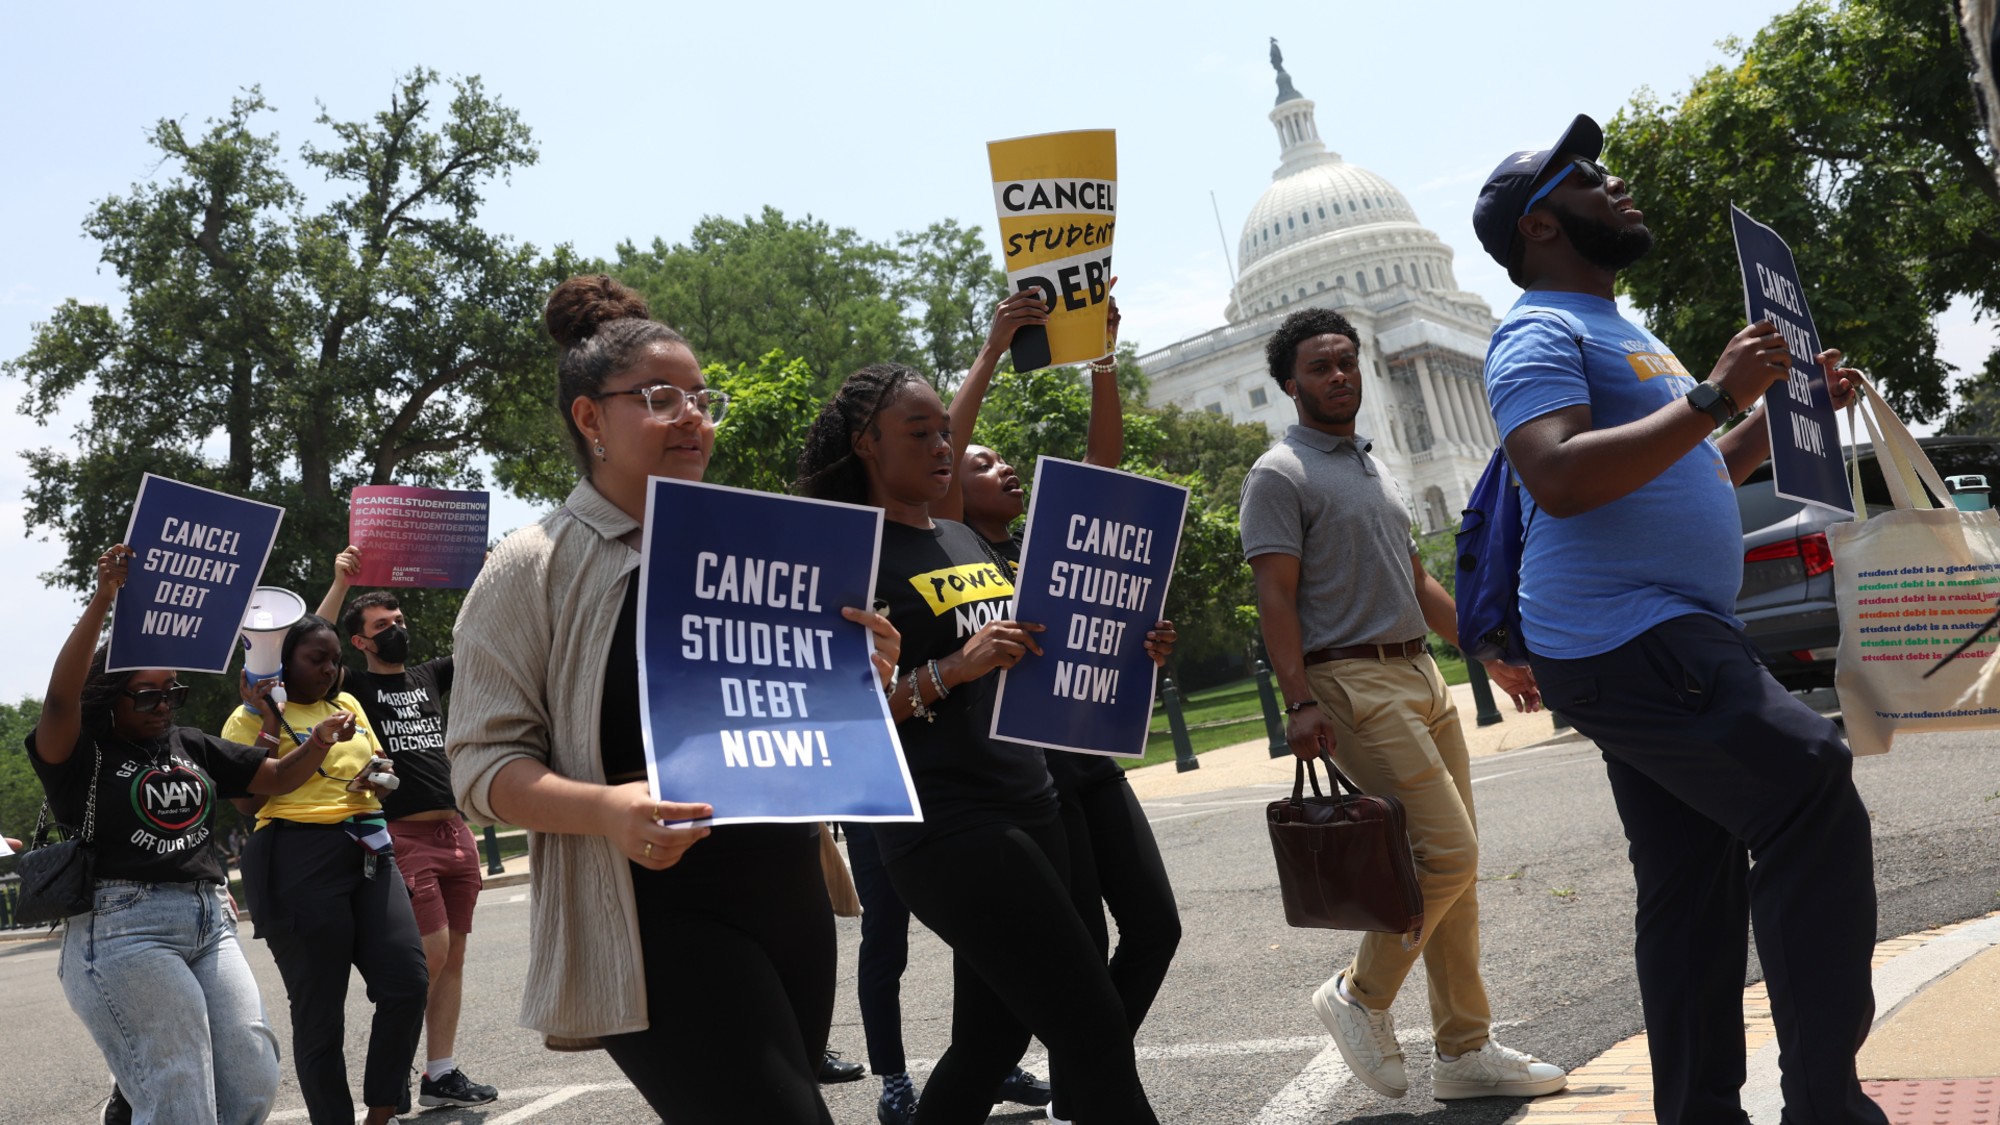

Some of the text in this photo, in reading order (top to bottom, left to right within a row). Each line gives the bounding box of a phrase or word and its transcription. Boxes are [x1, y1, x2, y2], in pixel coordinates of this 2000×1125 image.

[1002, 181, 1114, 212] CANCEL
[1007, 222, 1114, 257] STUDENT
[1756, 262, 1803, 317] CANCEL
[1790, 411, 1826, 458] NOW!
[355, 496, 487, 511] #CANCELSTUDENTDEBTNOW
[355, 507, 487, 521] #CANCELSTUDENTDEBTNOW
[160, 517, 241, 555] CANCEL
[354, 518, 487, 532] #CANCELSTUDENTDEBTNOW
[1066, 513, 1153, 565] CANCEL
[143, 548, 240, 585] STUDENT
[1858, 567, 1898, 578] student
[1900, 566, 1923, 575] debt
[154, 580, 209, 609] DEBT
[694, 551, 822, 613] CANCEL
[930, 568, 1010, 603] POWE
[1048, 560, 1152, 612] STUDENT
[1858, 581, 1898, 591] student
[1901, 580, 1924, 589] debt
[1858, 596, 1899, 605] student
[1901, 595, 1924, 603] debt
[1927, 594, 1937, 602] is
[1948, 592, 1981, 601] racial
[141, 610, 202, 639] NOW!
[955, 600, 1013, 639] MOV
[1859, 610, 1899, 619] student
[1902, 609, 1926, 617] debt
[1929, 608, 1938, 616] is
[1860, 624, 1901, 633] student
[1904, 622, 1927, 631] debt
[681, 613, 833, 670] STUDENT
[1066, 613, 1126, 656] DEBT
[1861, 638, 1902, 647] student
[1904, 637, 1928, 646] debt
[1862, 653, 1903, 662] student
[1906, 652, 1930, 660] debt
[1053, 660, 1119, 705] NOW!
[393, 704, 421, 719] WAS
[720, 677, 808, 718] DEBT
[381, 717, 442, 736] WRONGLY
[1875, 706, 2000, 719] www.studentdebtcrisis.
[388, 733, 444, 752] DECIDED
[720, 730, 832, 768] NOW!
[145, 781, 202, 810] NAN
[130, 829, 157, 850] OFF
[157, 838, 185, 854] OUR
